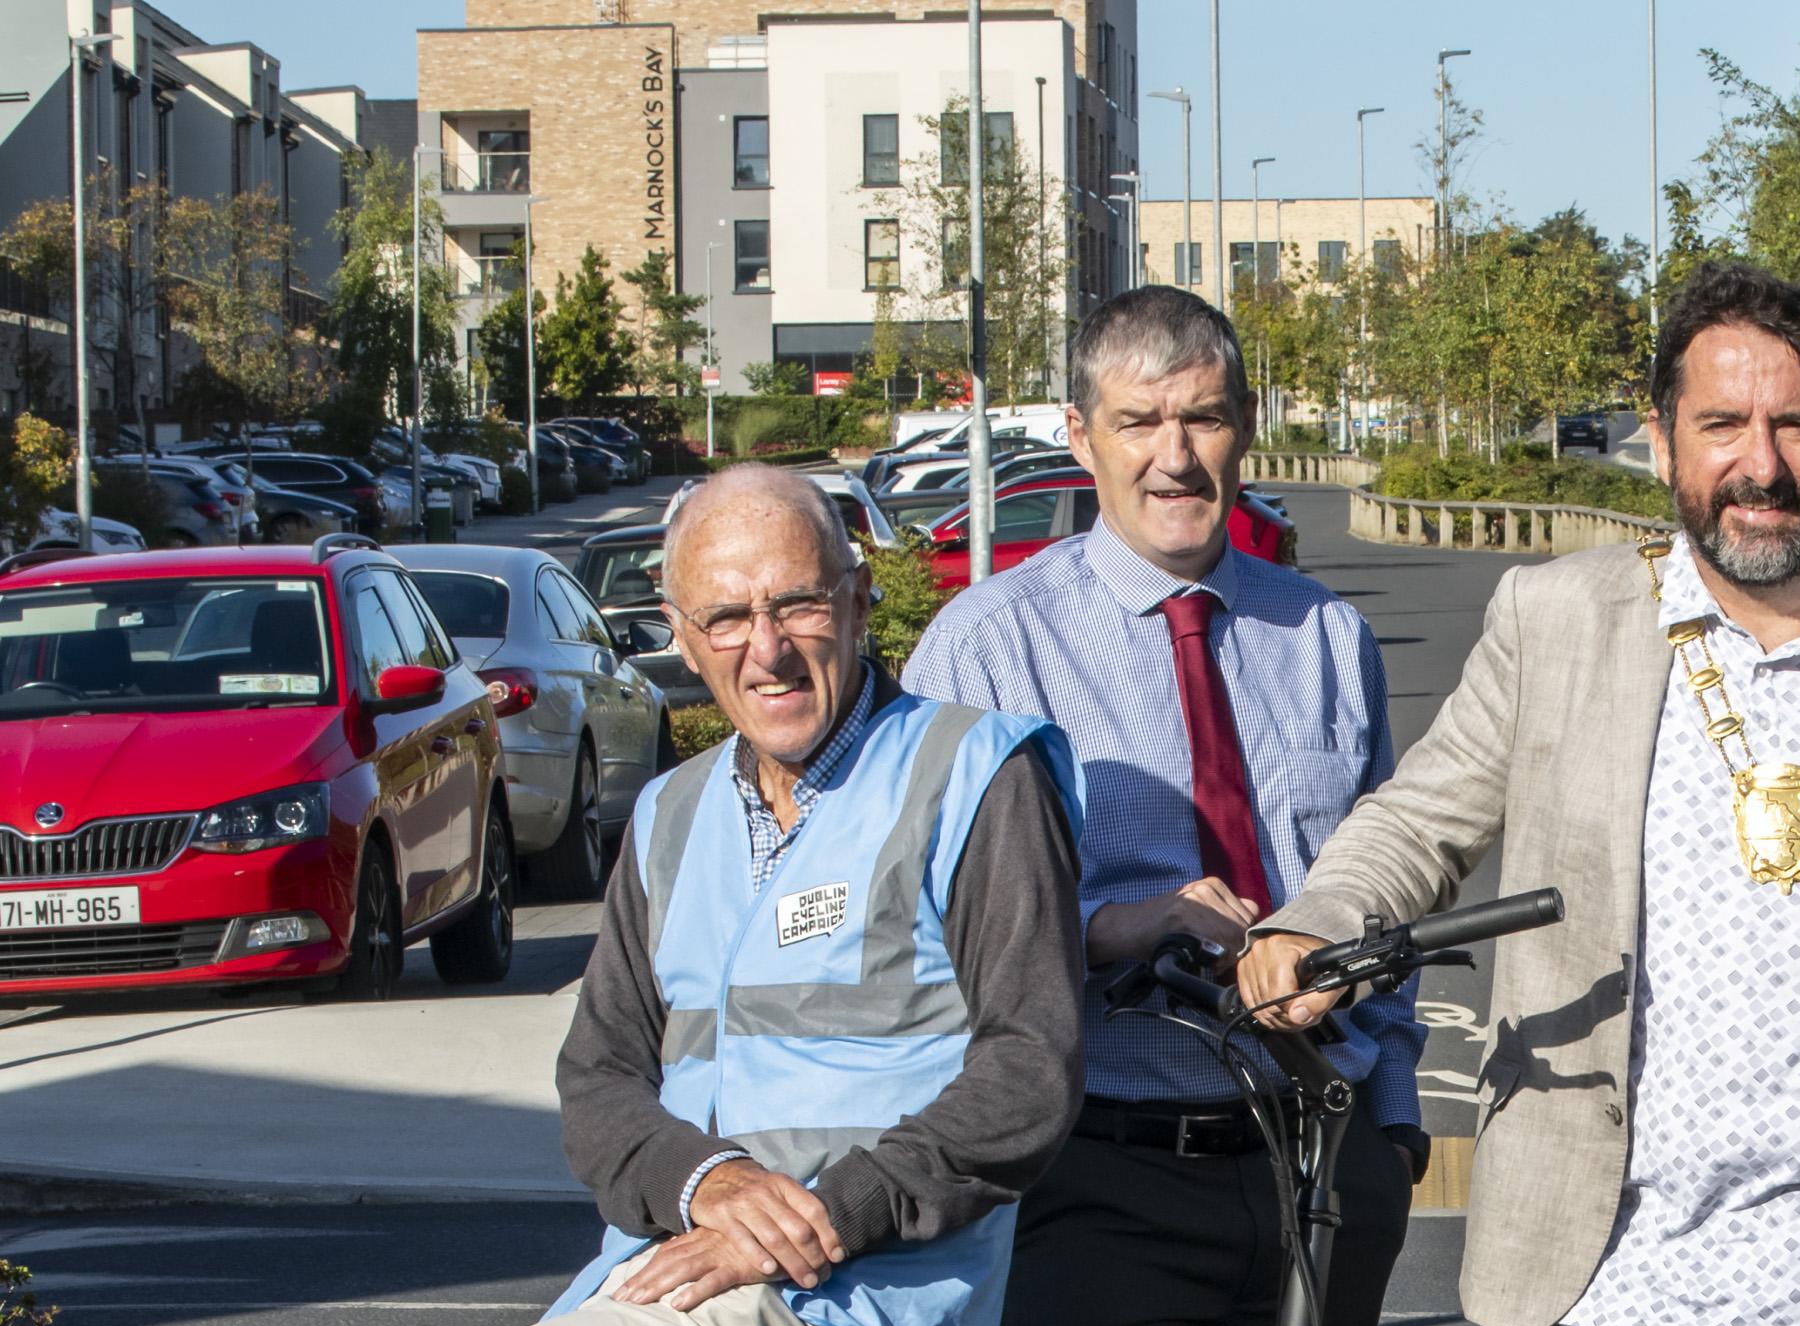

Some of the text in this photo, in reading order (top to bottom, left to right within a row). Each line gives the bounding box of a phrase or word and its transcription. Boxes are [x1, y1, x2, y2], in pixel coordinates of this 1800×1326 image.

[642, 46, 664, 92] BAY
[0, 896, 122, 927] 71-MH-965
[791, 899, 846, 924] CYCLING
[799, 886, 846, 908] DUBLIN
[782, 912, 844, 941] CAMPAIGN
